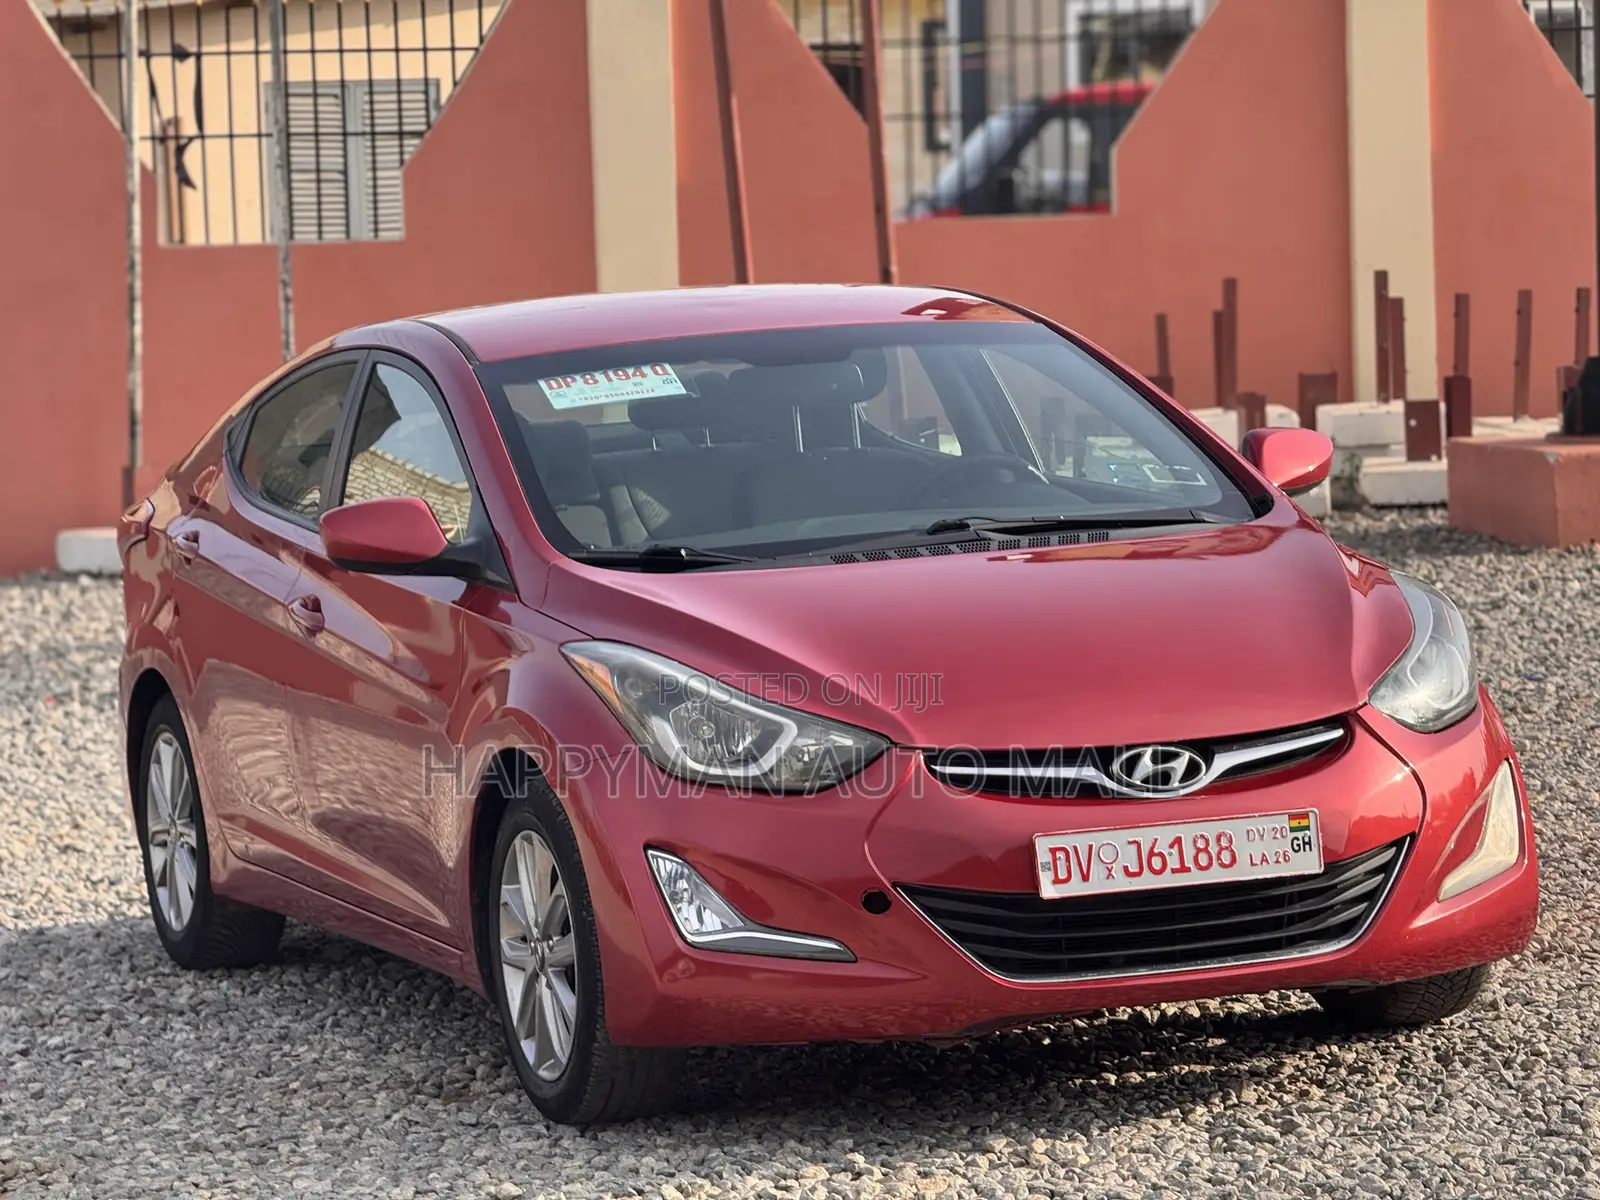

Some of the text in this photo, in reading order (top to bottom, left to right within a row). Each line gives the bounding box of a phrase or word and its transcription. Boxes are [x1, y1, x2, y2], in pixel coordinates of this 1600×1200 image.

[544, 375, 577, 390] DP
[579, 365, 648, 386] 8194
[649, 363, 671, 377] Q
[1246, 823, 1289, 842] DV 20
[1290, 833, 1313, 853] GH
[1048, 841, 1095, 885] DV
[1122, 829, 1239, 878] J6188
[1249, 848, 1292, 867] LA 26
